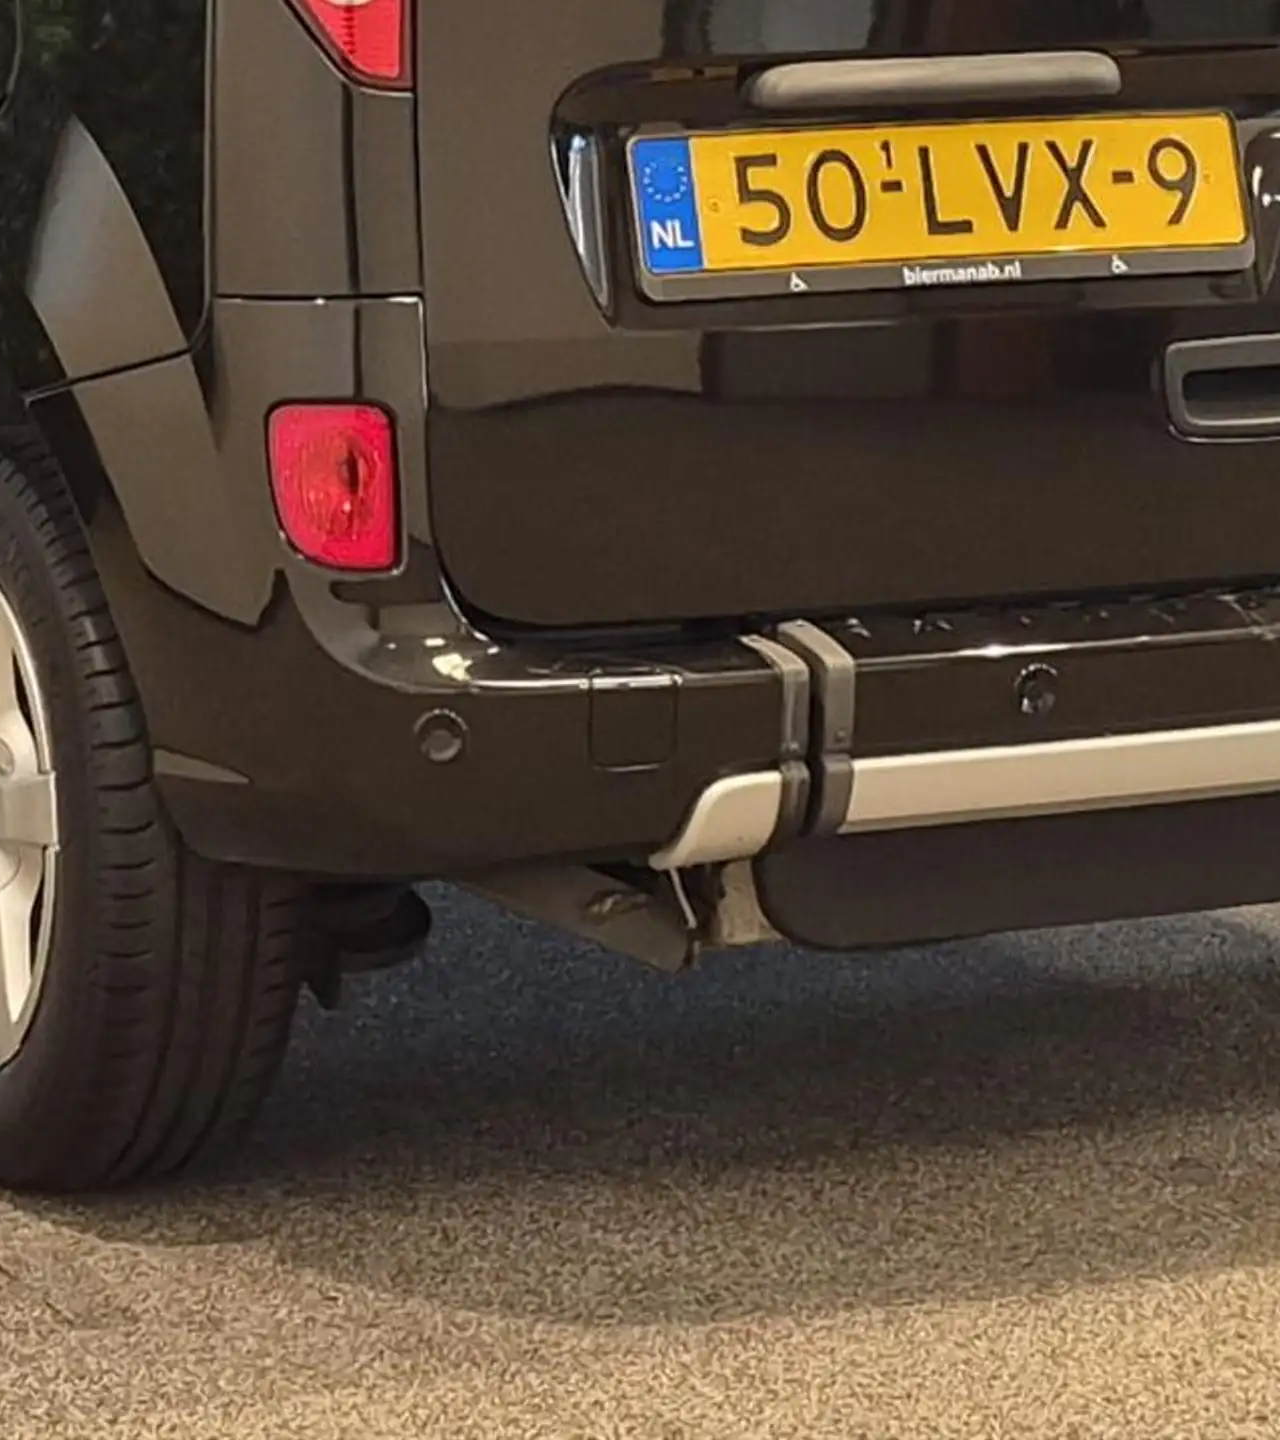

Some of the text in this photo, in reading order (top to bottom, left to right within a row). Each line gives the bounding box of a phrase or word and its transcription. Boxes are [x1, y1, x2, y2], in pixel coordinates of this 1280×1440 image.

[652, 137, 1196, 249] NL 50-LVX-9
[902, 260, 1021, 285] biermanab.nl
